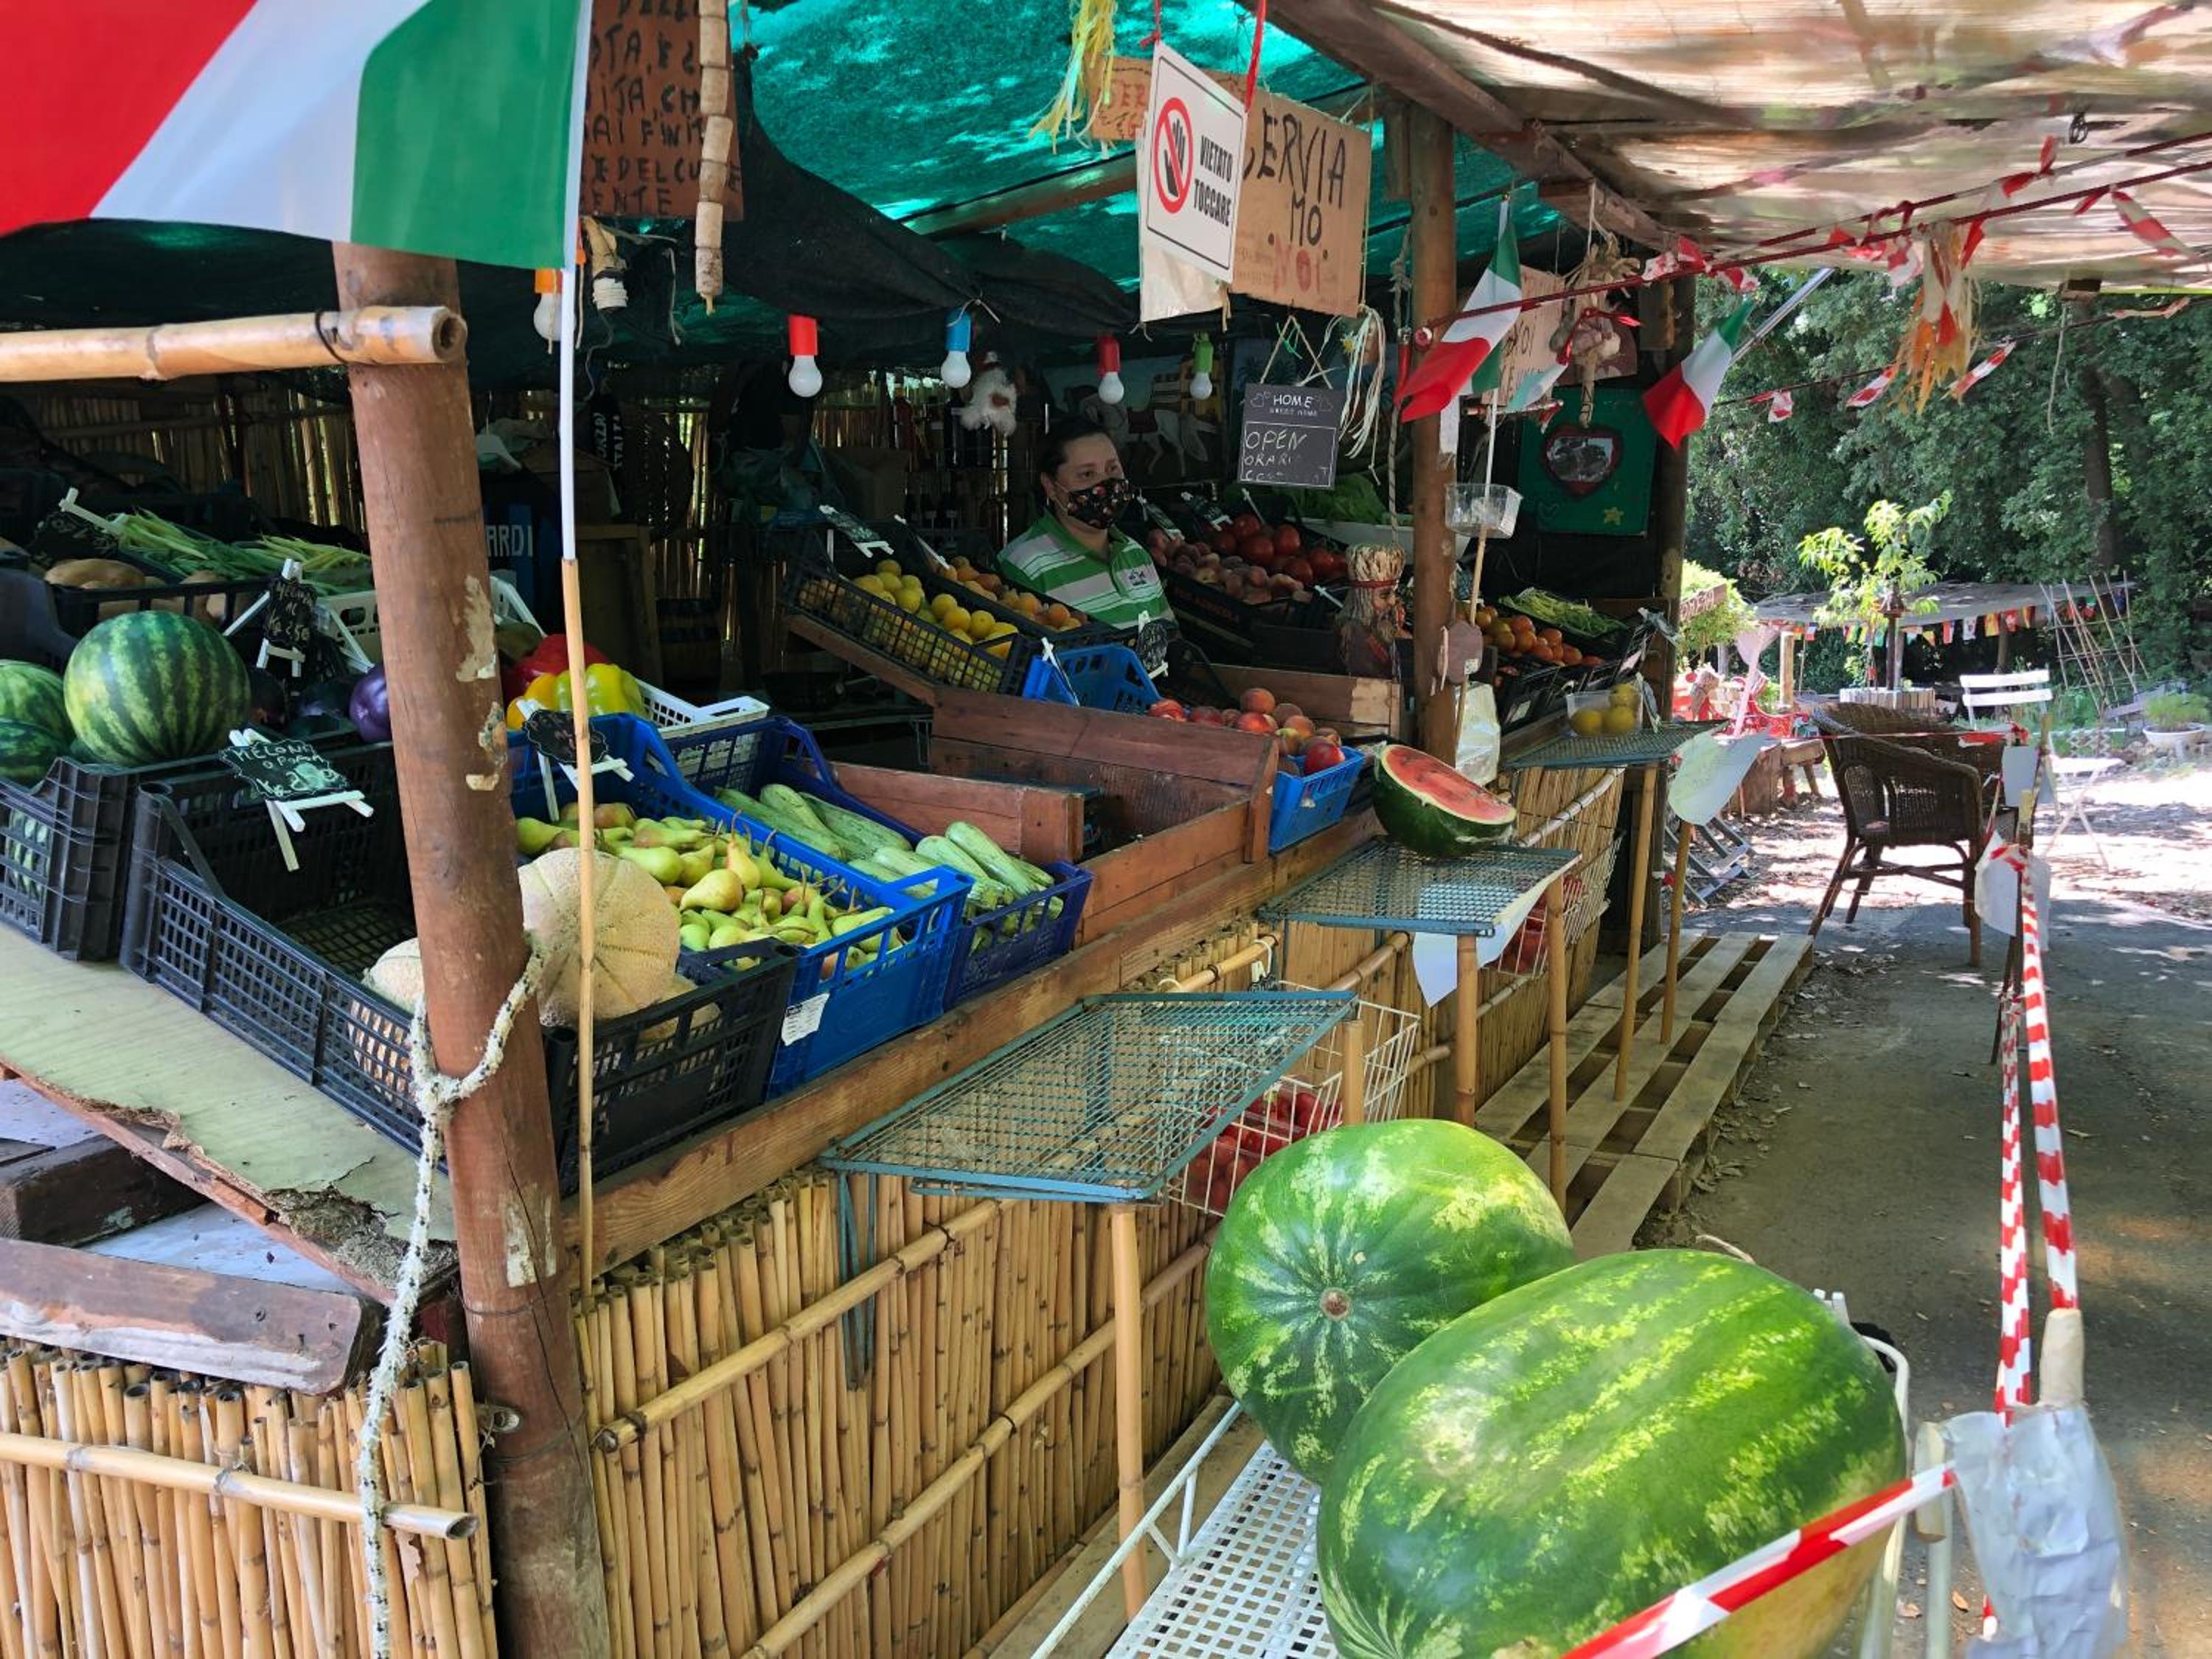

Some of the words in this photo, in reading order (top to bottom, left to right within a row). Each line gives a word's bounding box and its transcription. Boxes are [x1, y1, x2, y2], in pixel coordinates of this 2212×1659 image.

[584, 114, 624, 145] AI
[640, 115, 704, 146] FINIT
[1200, 134, 1233, 183] VIETATO
[581, 186, 672, 215] ENTE
[1194, 178, 1231, 226] TOCCARE
[1273, 394, 1313, 408] HOME
[1245, 428, 1308, 451] OPEN
[485, 524, 534, 557] ARDI
